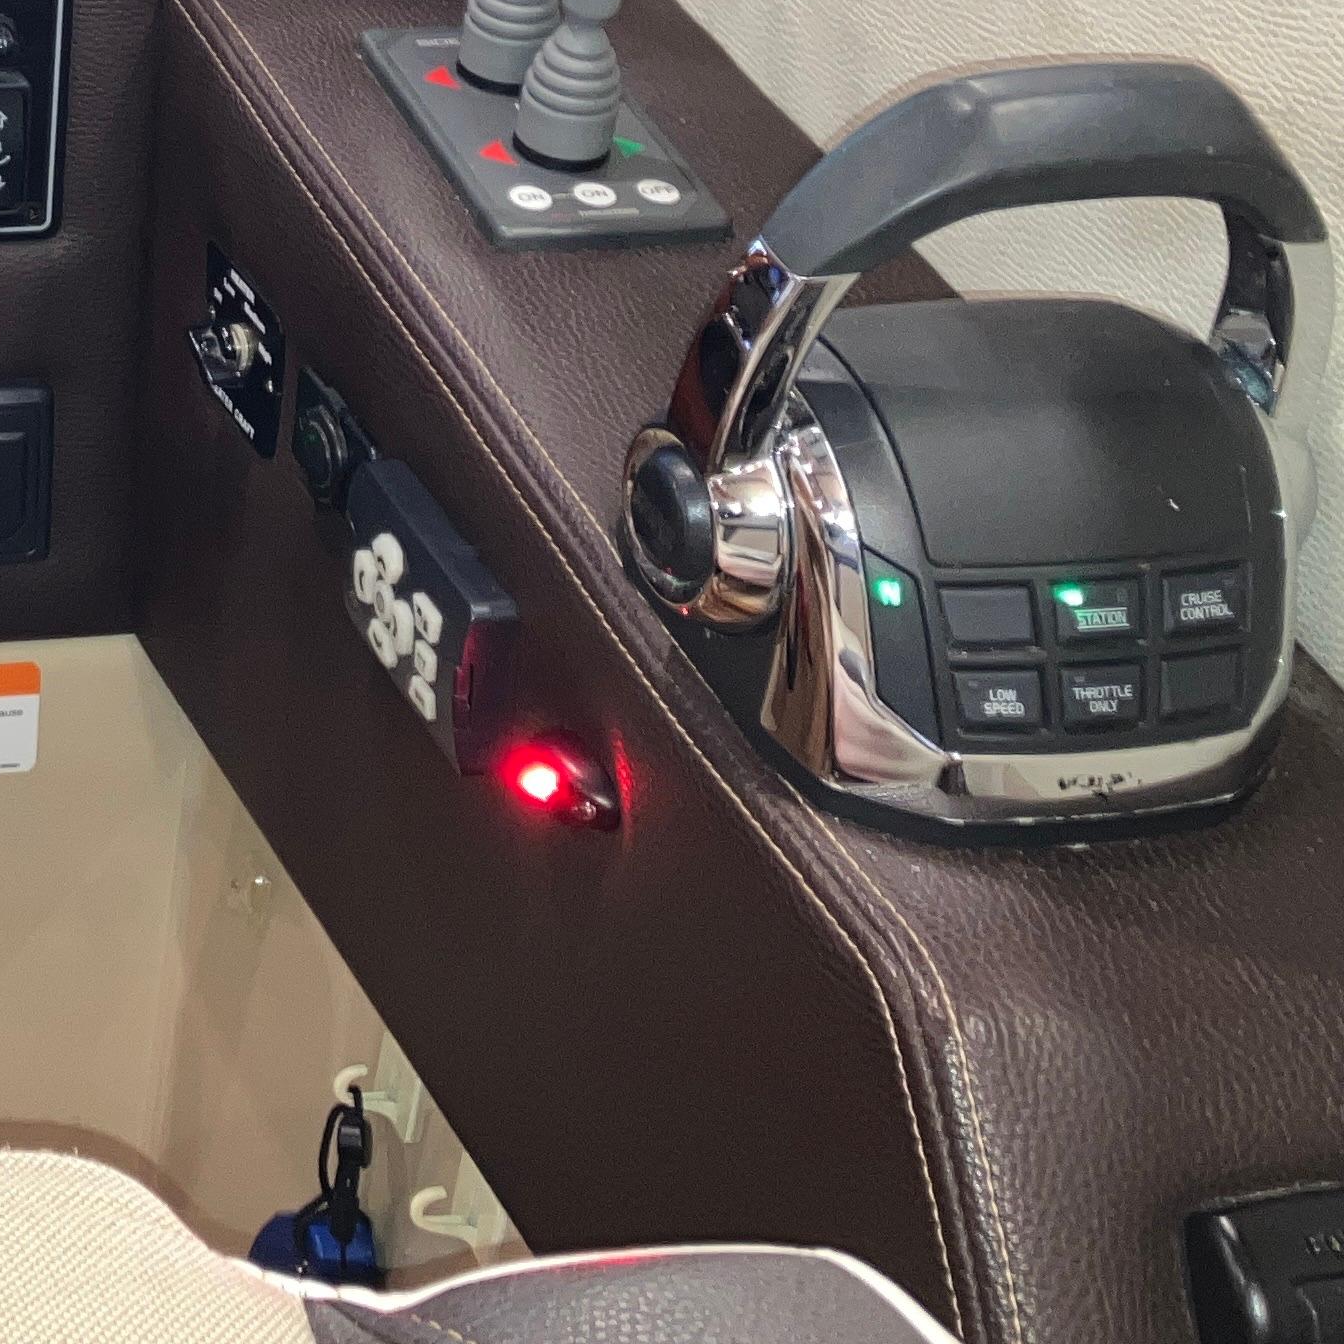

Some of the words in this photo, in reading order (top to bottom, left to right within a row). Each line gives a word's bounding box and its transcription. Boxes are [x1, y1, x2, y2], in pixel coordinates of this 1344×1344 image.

[580, 189, 609, 199] ON
[876, 580, 903, 607] N
[1180, 589, 1224, 606] CRUISE
[1076, 609, 1128, 628] STATION
[1180, 605, 1235, 622] CONTROL
[989, 688, 1017, 702] LOW
[1072, 684, 1134, 700] THROTTLE
[983, 701, 1025, 717] SPEED
[1089, 699, 1119, 713] ONLY
